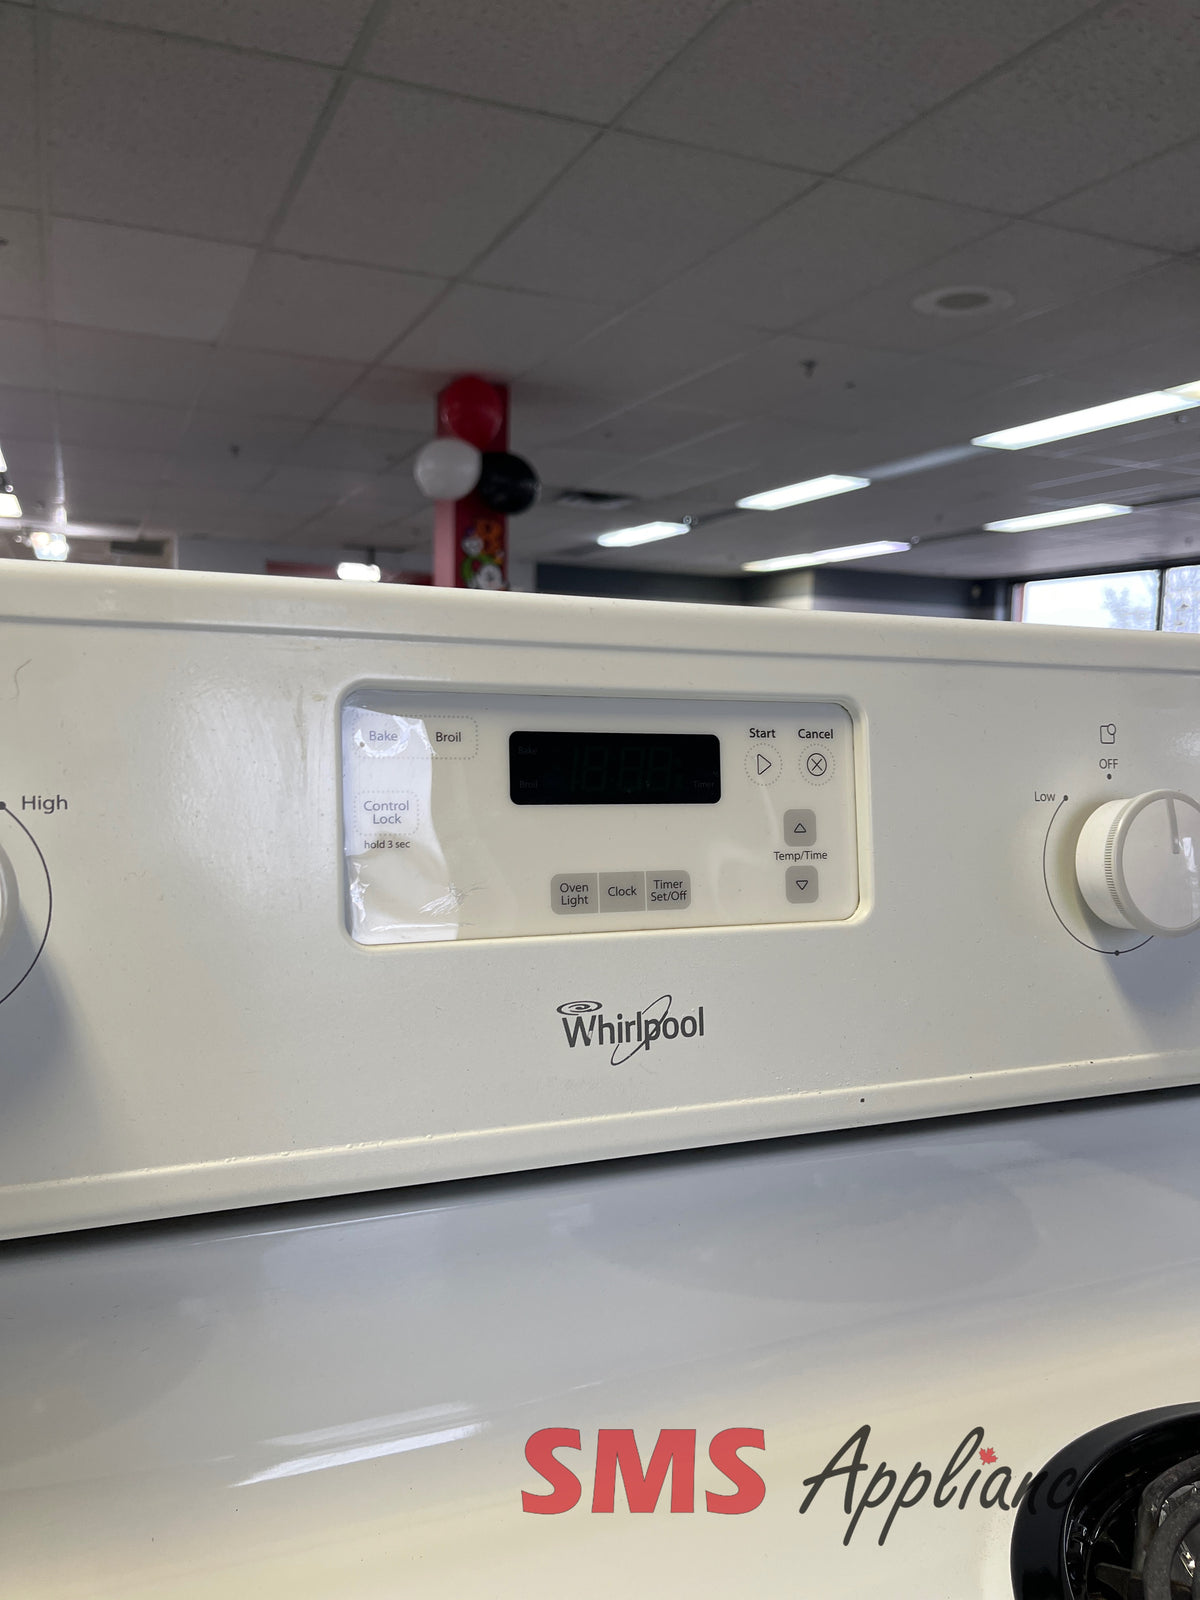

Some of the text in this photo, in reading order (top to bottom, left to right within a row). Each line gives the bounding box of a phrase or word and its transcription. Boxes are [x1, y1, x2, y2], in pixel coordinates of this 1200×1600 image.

[368, 730, 399, 742] Bake
[435, 731, 462, 743] Broil
[749, 728, 776, 739] Start
[797, 728, 834, 740] Cancel
[1098, 758, 1119, 770] OFF
[1034, 791, 1056, 802] Low
[22, 794, 68, 815] High
[363, 800, 410, 812] Control
[372, 813, 402, 825] Lock
[363, 839, 411, 849] hold 3 sec
[773, 850, 828, 862] Temp/Time
[559, 882, 589, 893] Oven
[653, 879, 684, 890] Timer
[607, 886, 637, 897] Clock
[650, 890, 688, 902] Set/Off
[560, 894, 589, 908] Light
[560, 1004, 705, 1051] Whirlpool
